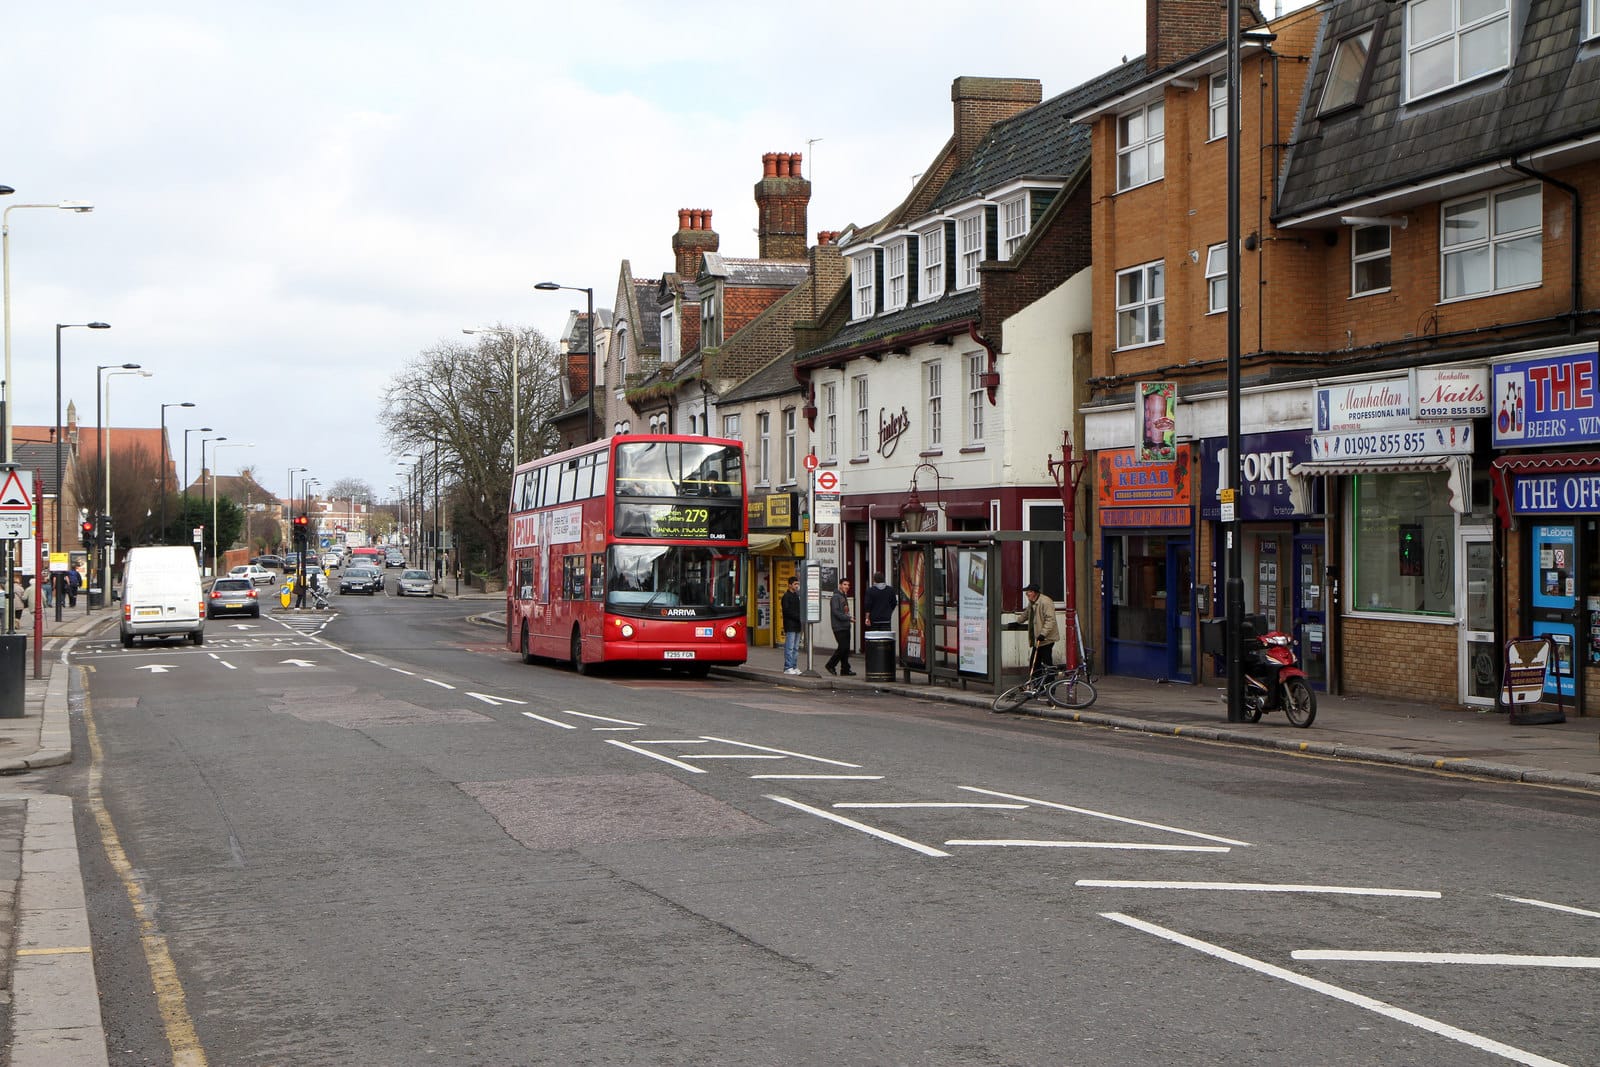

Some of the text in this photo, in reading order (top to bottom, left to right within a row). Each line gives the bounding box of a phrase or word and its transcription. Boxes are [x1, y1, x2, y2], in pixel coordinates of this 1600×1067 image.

[1435, 371, 1470, 381] Manhattan
[1420, 383, 1485, 404] Nails
[1528, 360, 1593, 413] THE
[1340, 386, 1401, 411] Manhattan
[1348, 409, 1394, 420] PROFESSIONAL
[1420, 406, 1486, 416] 01992 855 855
[1528, 419, 1566, 438] BEERS
[1344, 432, 1425, 454] 01992 855 855
[1119, 470, 1169, 486] KEBAB
[1240, 483, 1284, 496] OME
[1518, 477, 1600, 509] THE OFF
[685, 509, 708, 523] 279
[1547, 527, 1573, 537] Lebara
[667, 608, 696, 616] ARRIVA
